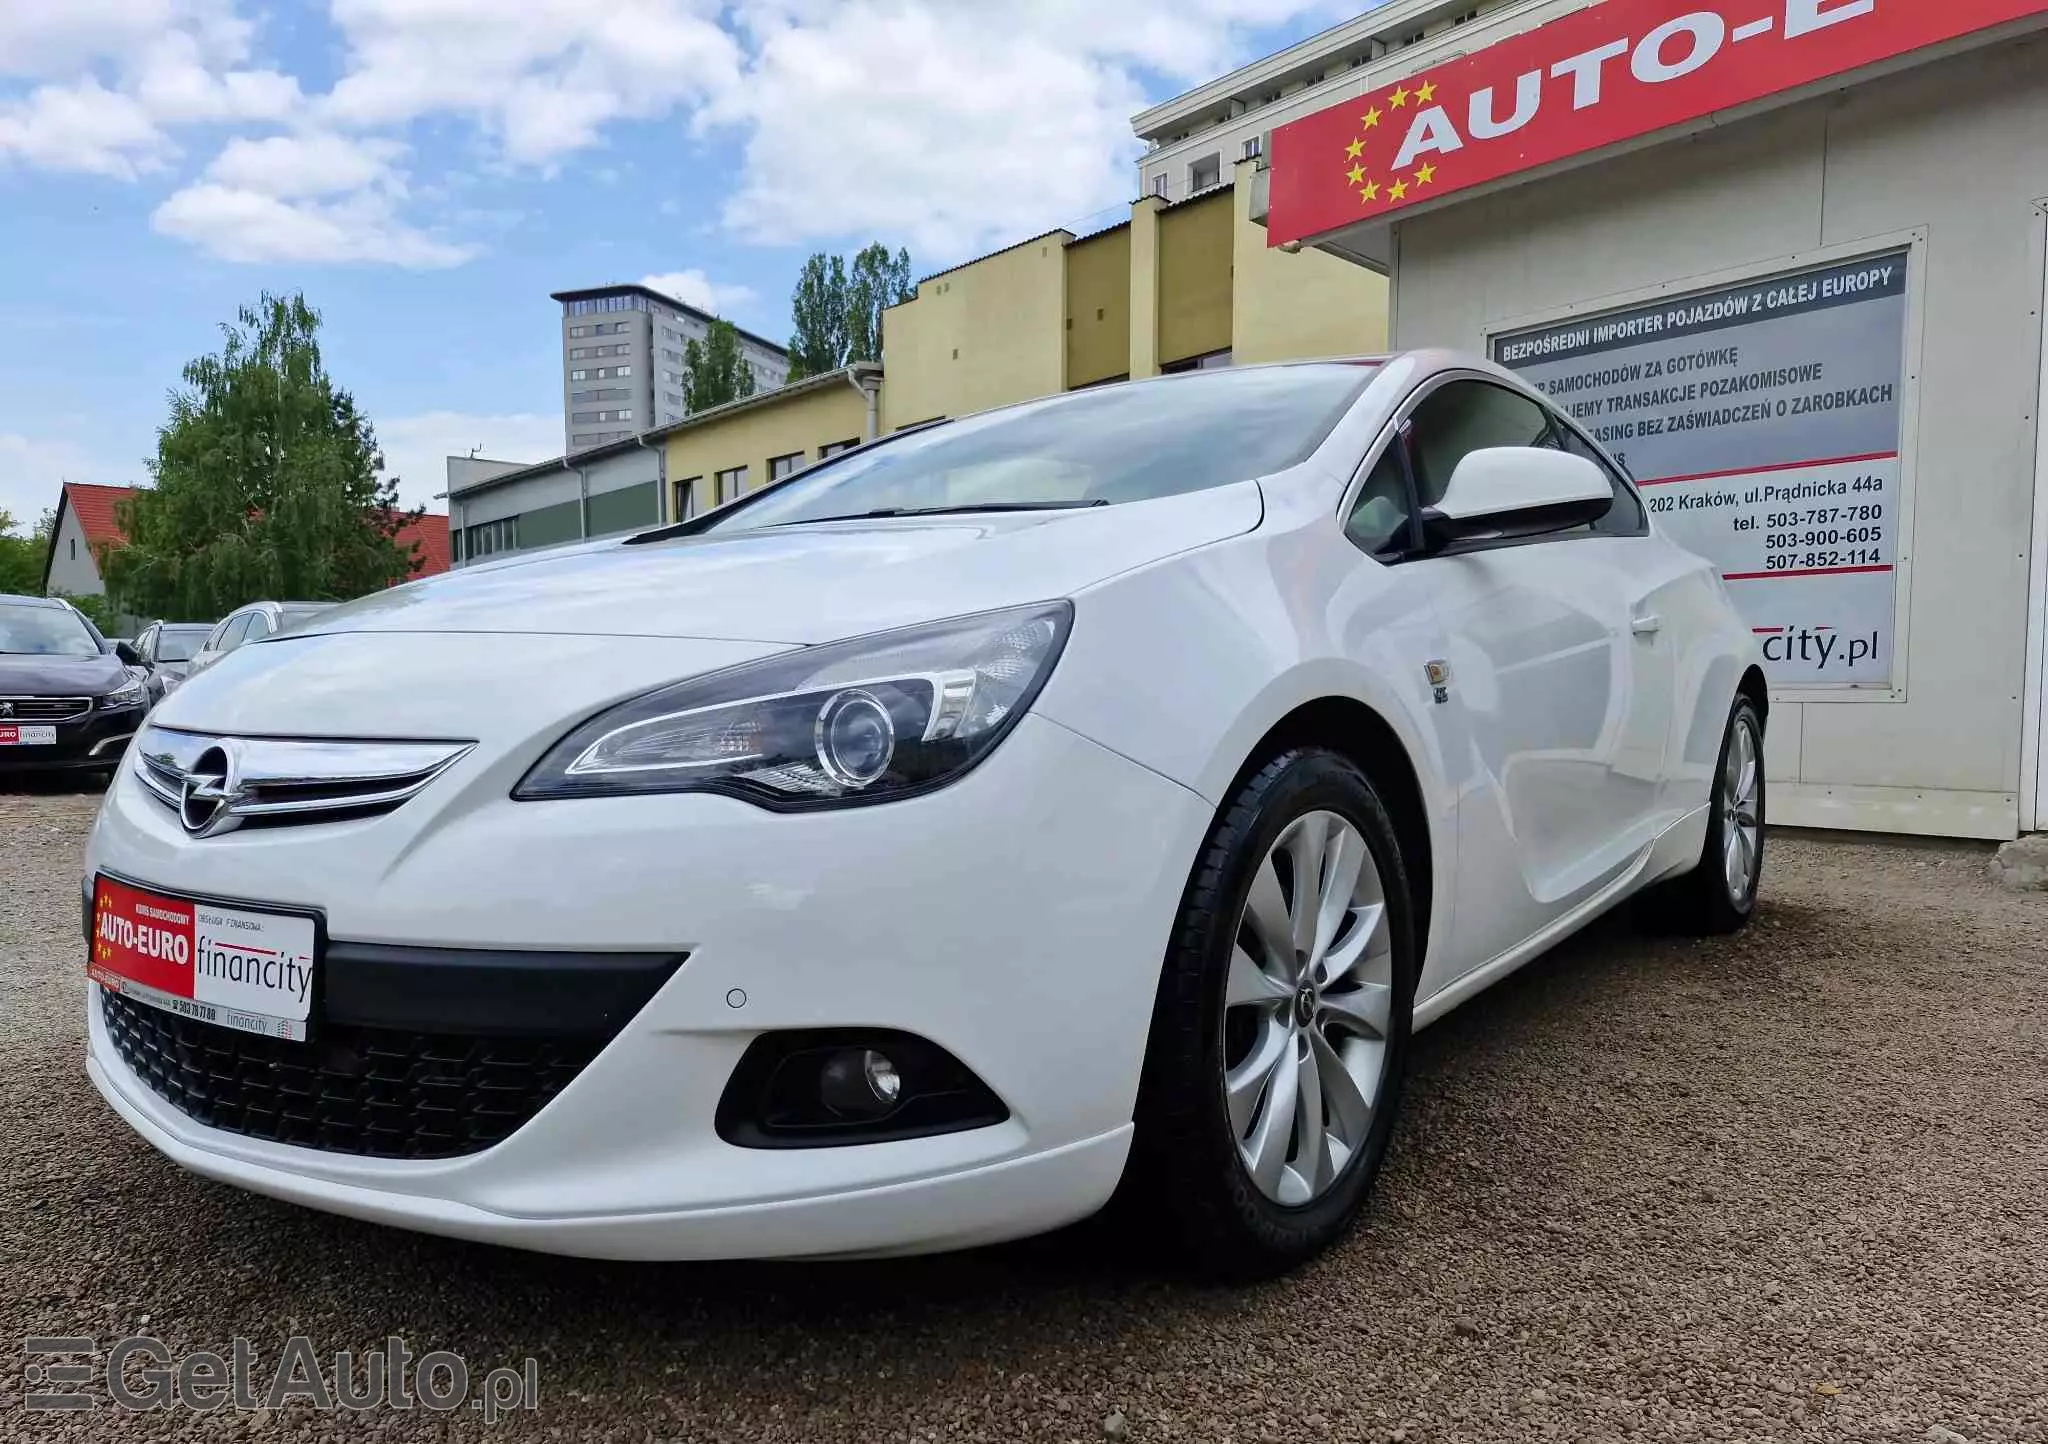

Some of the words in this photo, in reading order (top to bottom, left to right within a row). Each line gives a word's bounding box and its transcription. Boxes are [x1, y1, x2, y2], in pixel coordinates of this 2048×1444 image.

[1503, 327, 1590, 362] BEZPOŚREDNI
[1593, 316, 1663, 344] IMPORTER
[1667, 296, 1748, 329] POJAZDÓW
[1751, 293, 1763, 312] Z
[1766, 281, 1816, 308] CAŁEJ
[1822, 266, 1892, 298] EUROPY
[1549, 363, 1641, 395] SAMOCHODÓW
[1644, 360, 1663, 379] ZA
[1667, 346, 1738, 374] GOTÓWKĘ
[1607, 384, 1696, 412] TRANSAKCJE
[1700, 362, 1823, 399] POZAKOMISOWE
[1637, 417, 1663, 436] BEZ
[1667, 399, 1771, 431] ZAŚWIADCZEŃ
[1776, 399, 1787, 417] O
[1792, 383, 1893, 415] ZAROBKACH
[1679, 491, 1739, 510] Kraków,
[1852, 475, 1883, 492] 44a
[1733, 515, 1760, 531] tel.
[1766, 504, 1882, 529] 503-787-780
[1766, 526, 1882, 549] 503-900-605
[1766, 548, 1881, 570] 507-852-114
[1762, 625, 1878, 669] city.pl
[100, 911, 189, 965] AUTO-EURO
[197, 935, 314, 1003] financity
